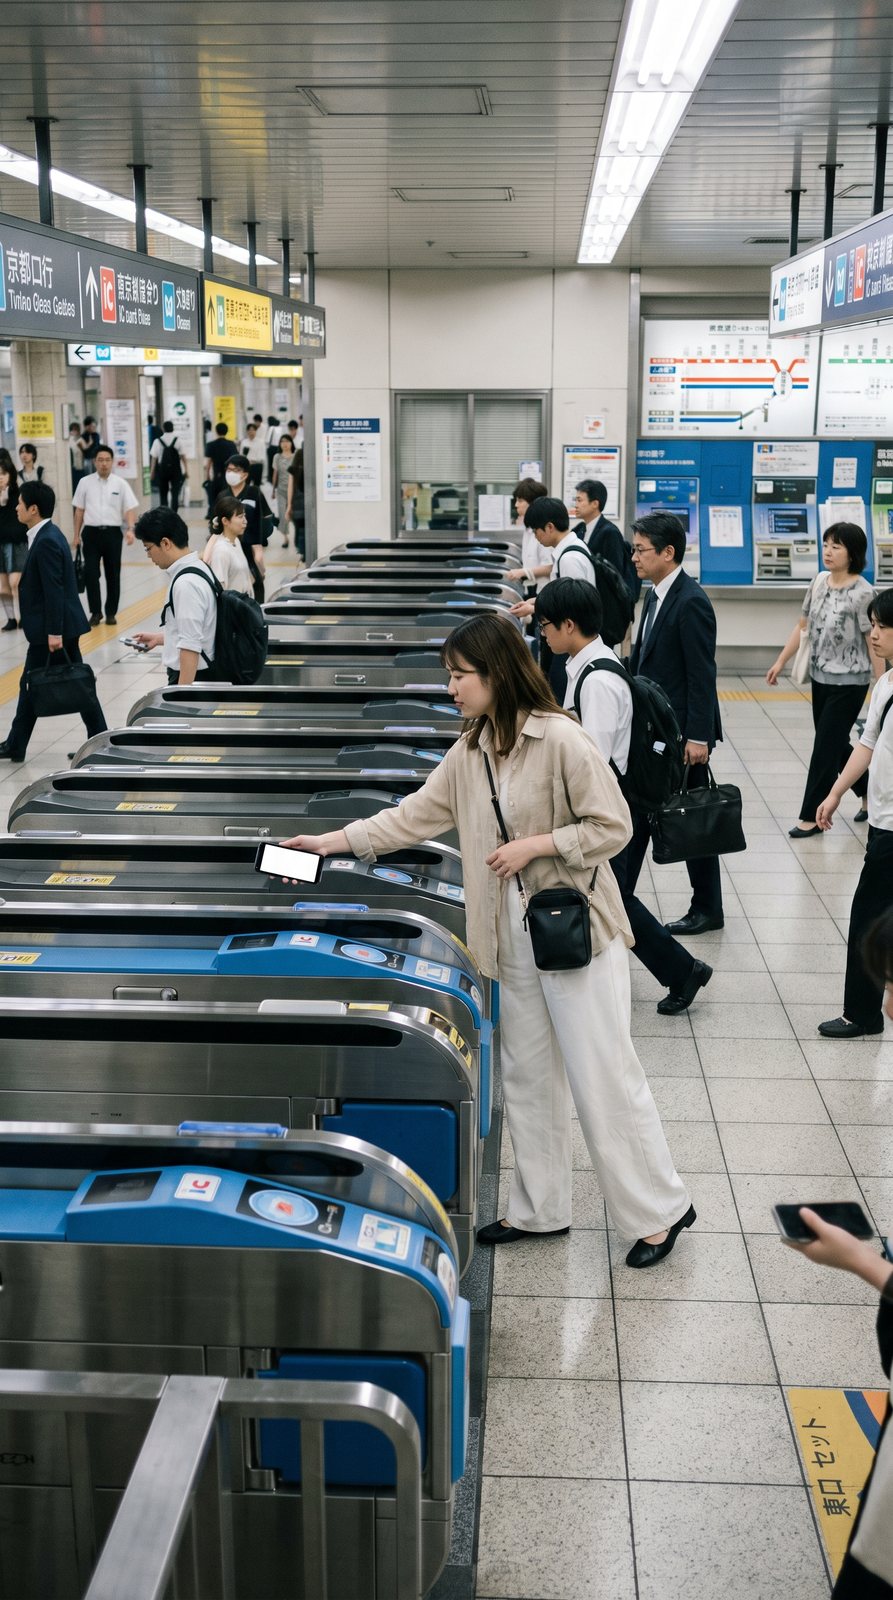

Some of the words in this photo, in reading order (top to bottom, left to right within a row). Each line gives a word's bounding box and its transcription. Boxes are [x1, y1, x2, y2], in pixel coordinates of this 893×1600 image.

[801, 1417, 835, 1468] セット
[817, 1479, 851, 1516] 東口
